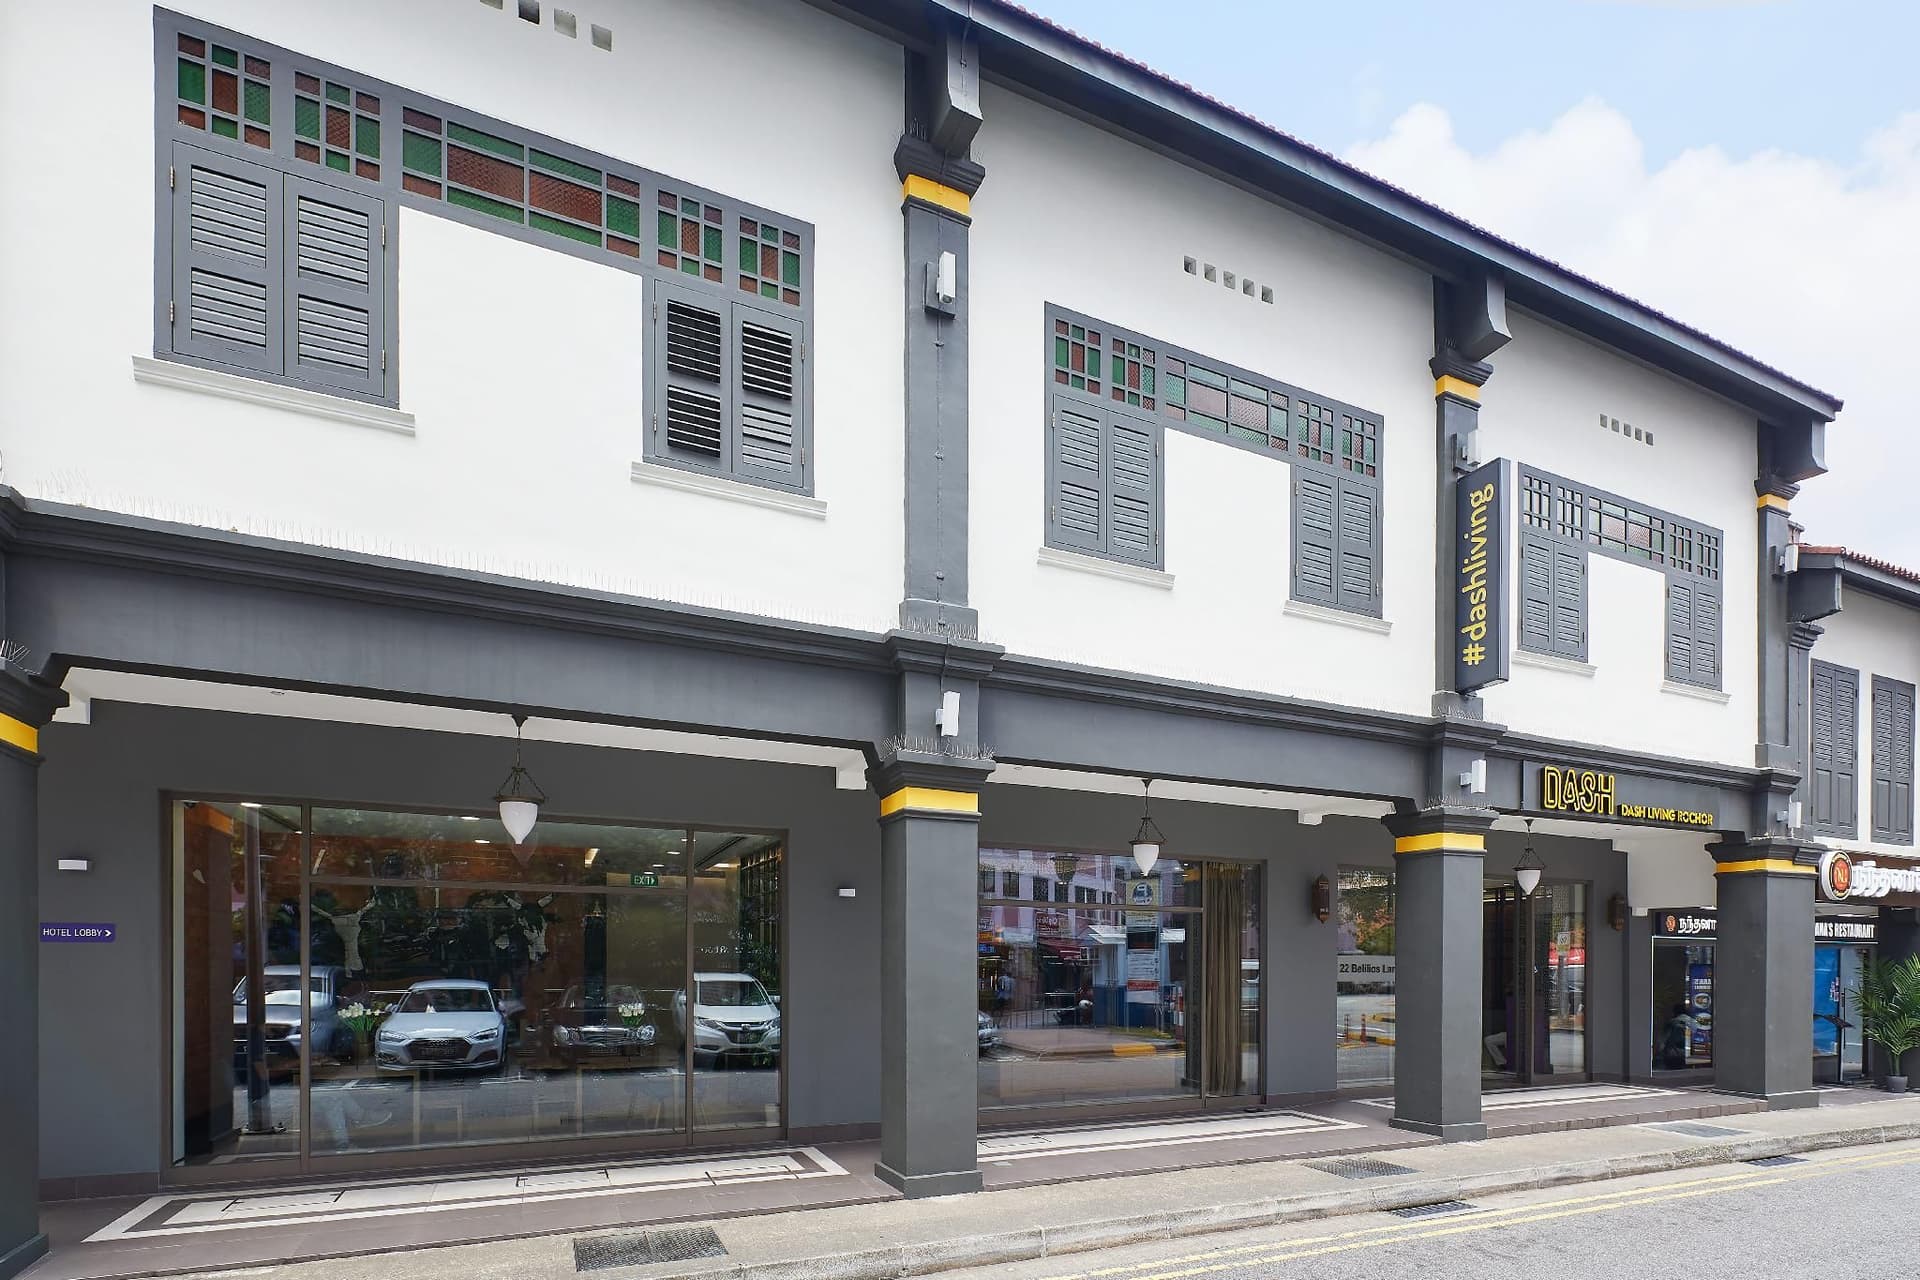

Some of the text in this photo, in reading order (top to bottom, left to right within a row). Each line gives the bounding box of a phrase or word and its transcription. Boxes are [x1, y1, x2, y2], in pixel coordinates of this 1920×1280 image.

[1461, 482, 1495, 667] #dashliving
[1543, 765, 1615, 815] DASH
[1621, 804, 1713, 826] DASH LIVING ROCHOR
[634, 875, 651, 885] EXIT
[43, 928, 102, 937] HOTEL LOBBY
[1834, 923, 1875, 938] RESTAURANT
[1339, 963, 1350, 973] 22
